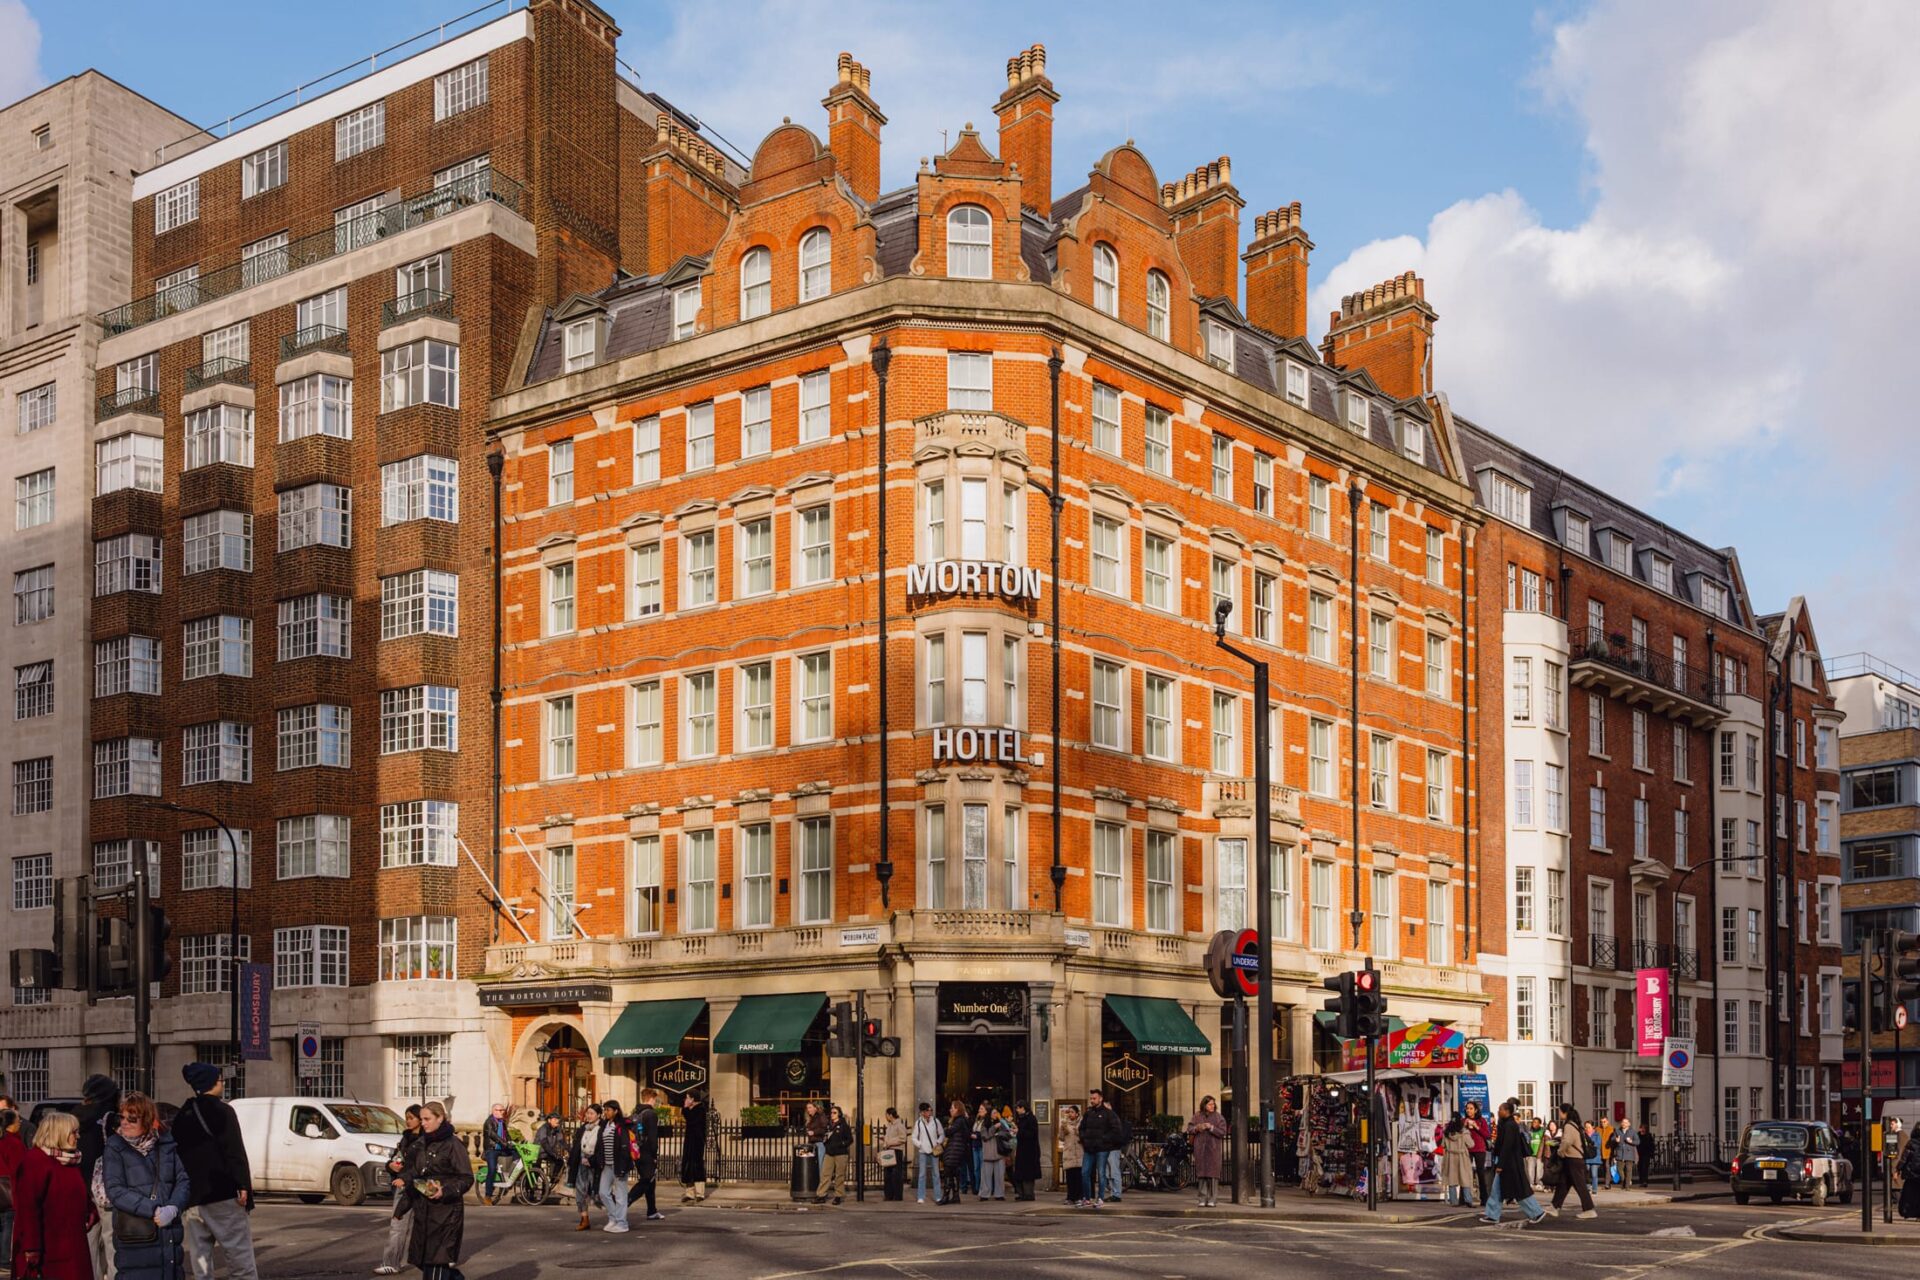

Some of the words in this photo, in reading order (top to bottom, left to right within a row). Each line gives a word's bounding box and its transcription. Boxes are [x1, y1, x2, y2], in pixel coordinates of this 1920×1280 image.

[906, 561, 1041, 600] MORTON
[932, 728, 1029, 762] HOTEL
[862, 932, 876, 940] PLACE
[486, 993, 504, 1002] THE
[510, 991, 548, 1001] MORTON
[554, 989, 587, 999] HOTEL
[953, 1002, 989, 1014] Number
[990, 1002, 1008, 1014] One
[1653, 997, 1663, 1040] BLOOMSBURY
[739, 1043, 769, 1051] FARMER
[1142, 1044, 1160, 1052] HOME
